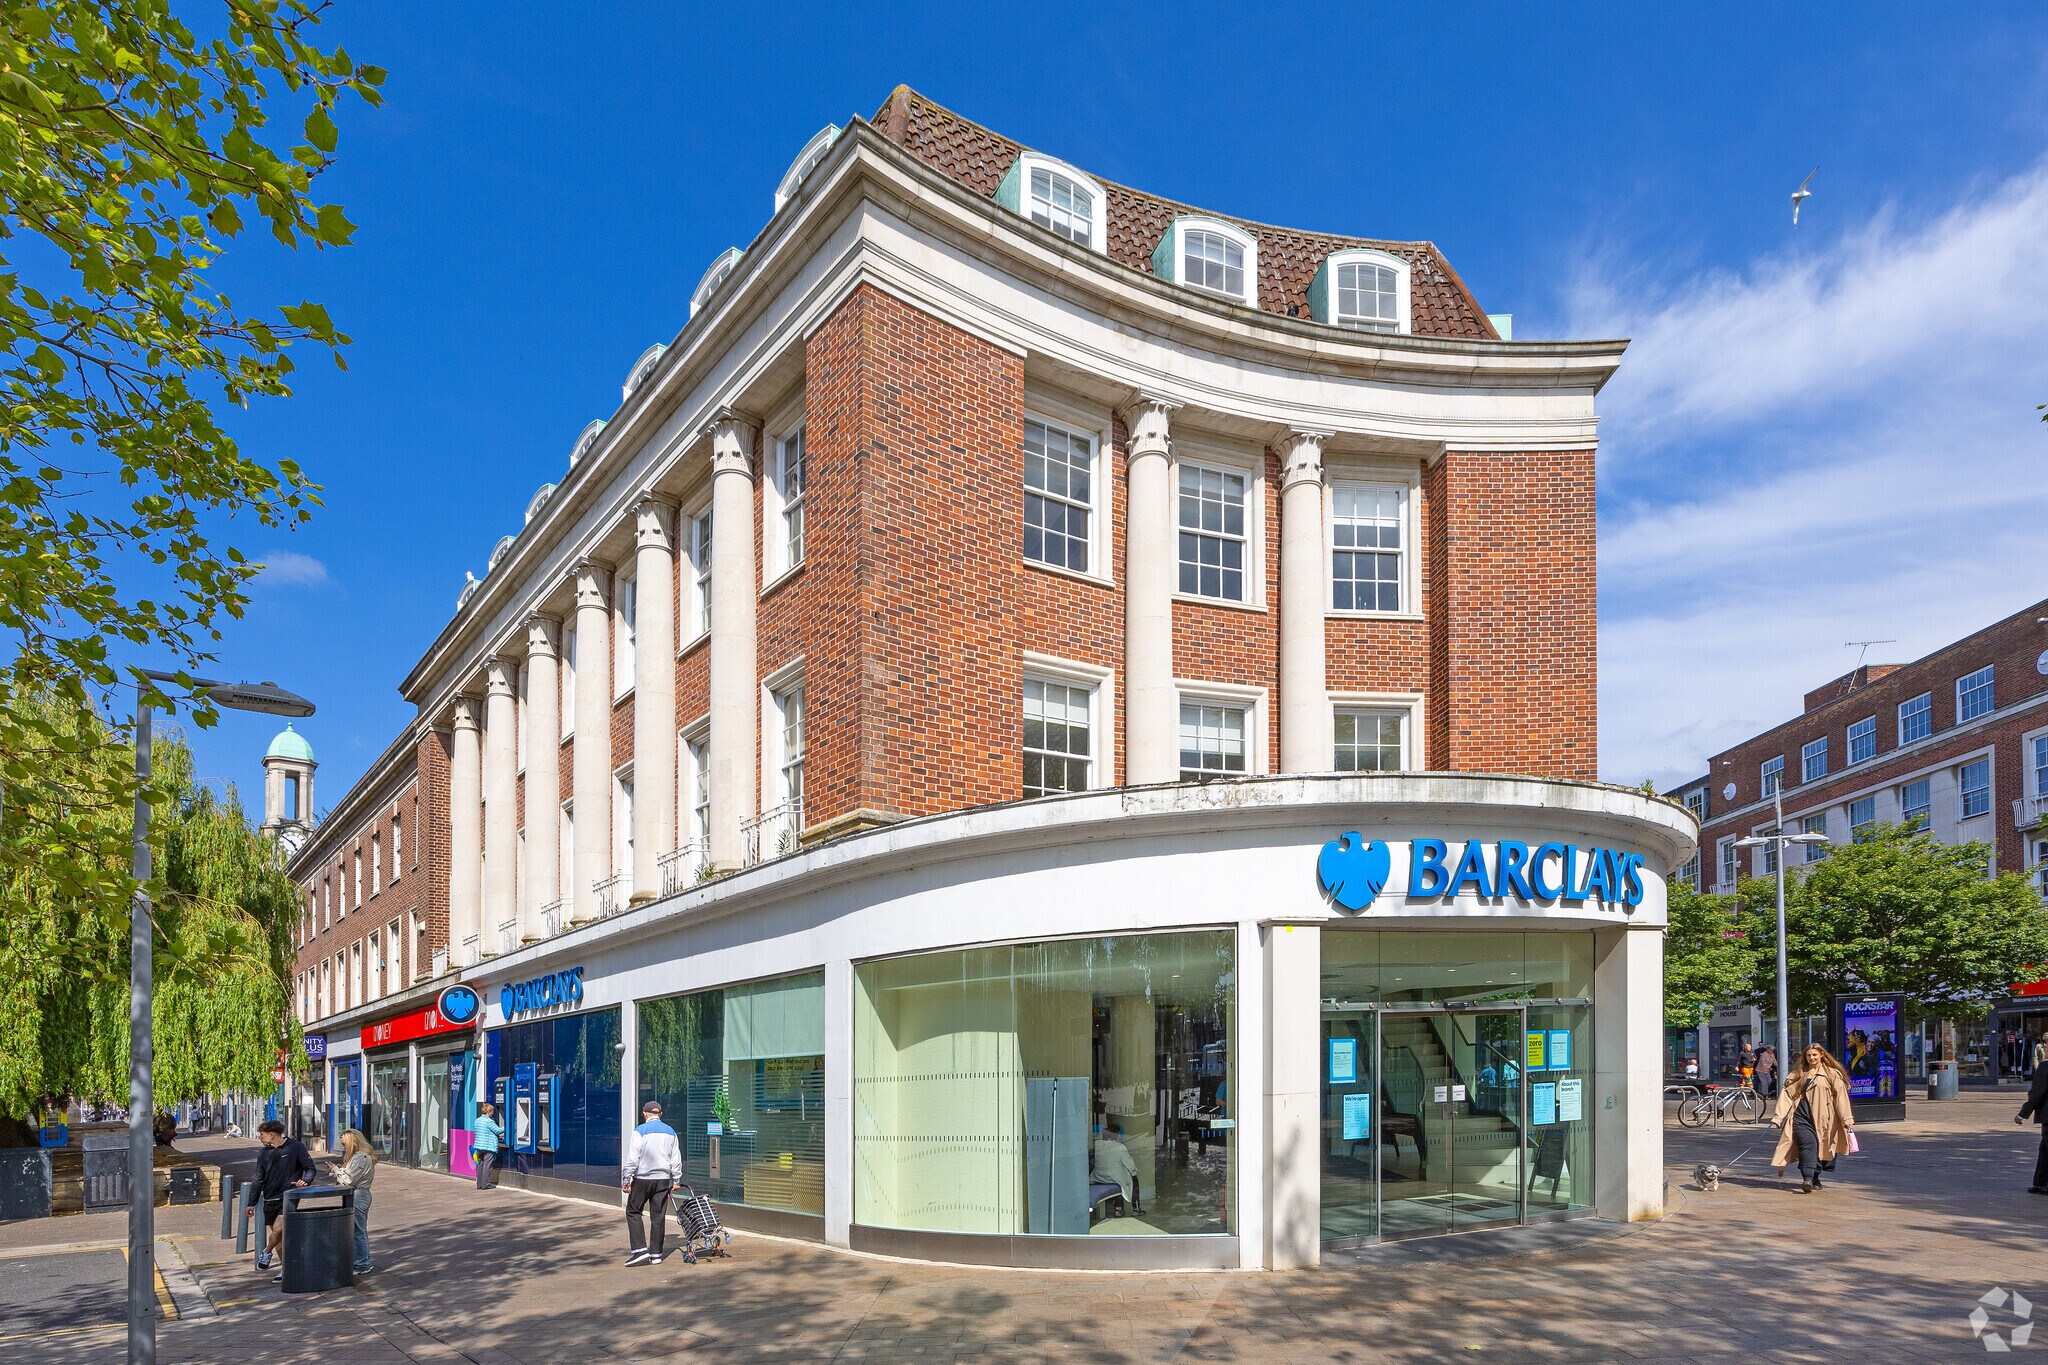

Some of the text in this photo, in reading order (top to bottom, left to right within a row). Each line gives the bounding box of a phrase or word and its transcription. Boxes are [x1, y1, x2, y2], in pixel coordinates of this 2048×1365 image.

[1408, 838, 1644, 906] BARCLAYS
[514, 966, 583, 1013] BARCLAYS
[1845, 1002, 1893, 1011] ROCKSTAR
[304, 1043, 323, 1052] LUS
